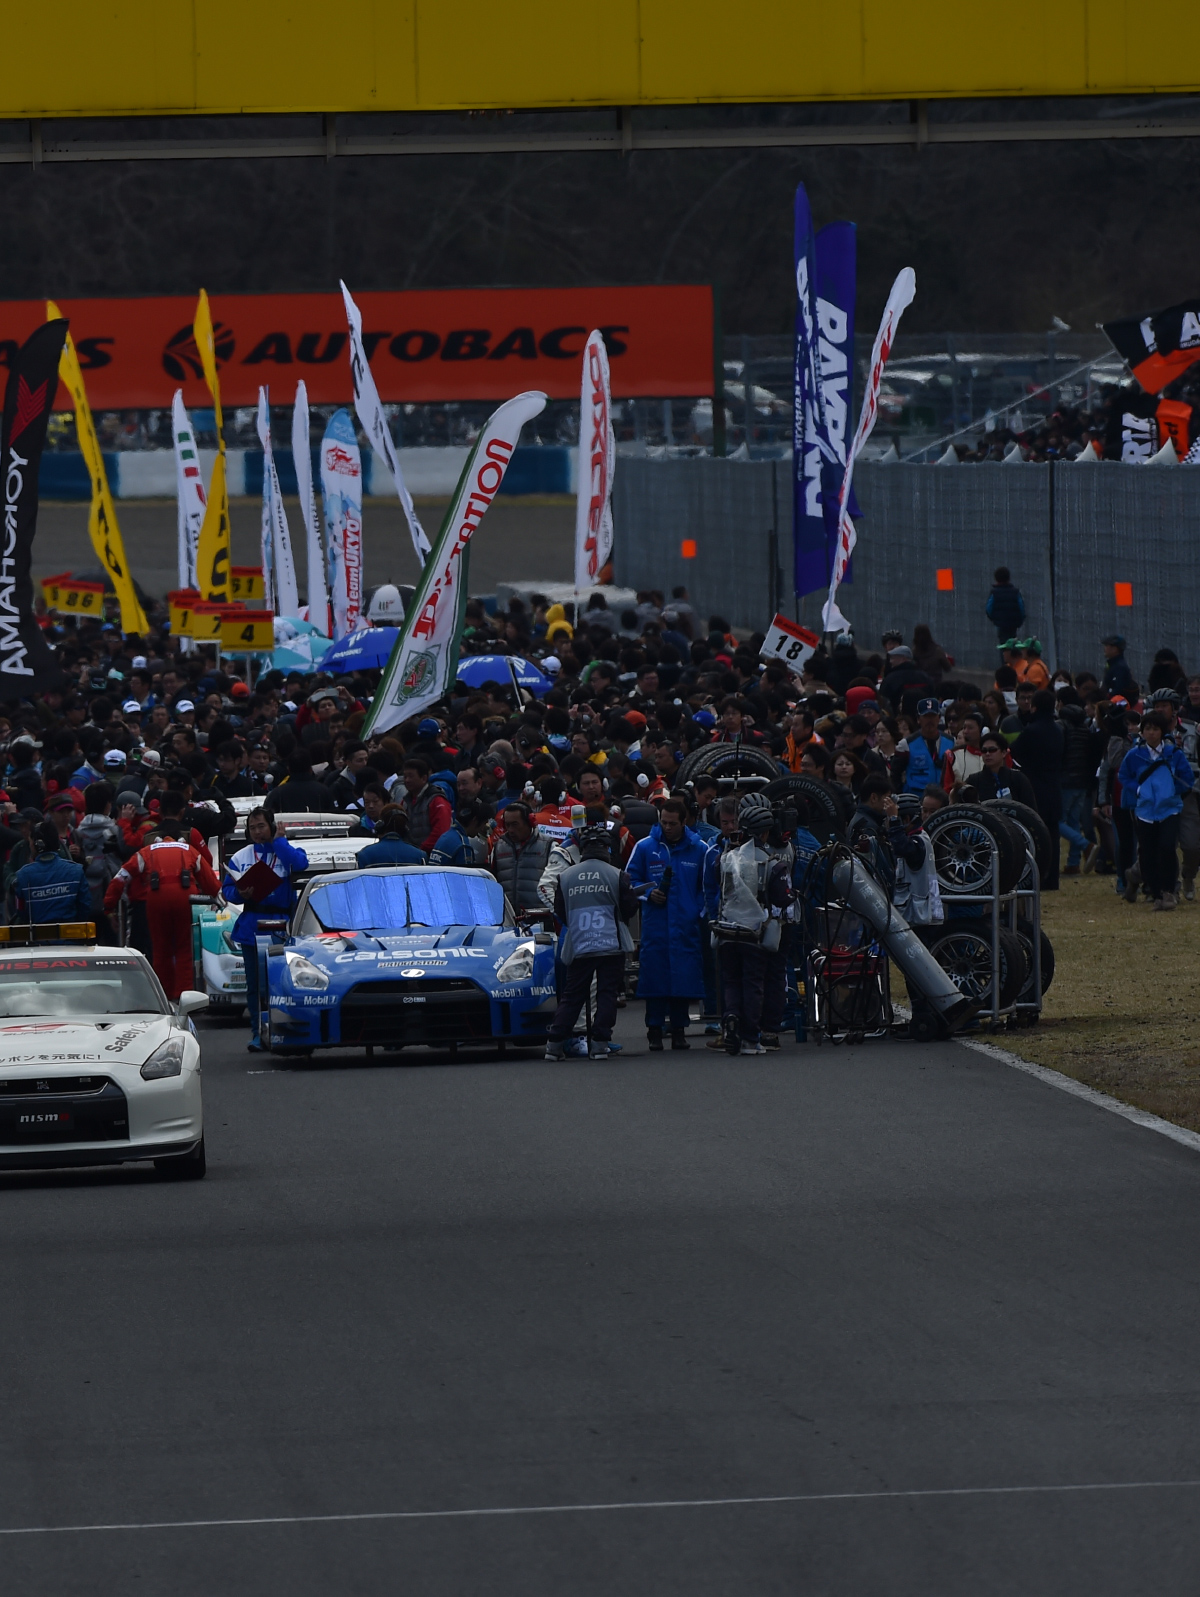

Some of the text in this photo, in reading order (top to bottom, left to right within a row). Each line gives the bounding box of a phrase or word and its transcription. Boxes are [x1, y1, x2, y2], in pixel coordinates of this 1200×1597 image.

[241, 624, 254, 642] 4
[775, 635, 804, 660] 18
[927, 810, 983, 831] POTENZA
[578, 871, 600, 881] GTA
[568, 884, 611, 897] OFFICIAL
[578, 910, 605, 931] 05
[304, 995, 328, 1005] Mobil
[491, 988, 515, 999] Mobil
[105, 1027, 139, 1053] Safety
[19, 1112, 70, 1123] nismo
